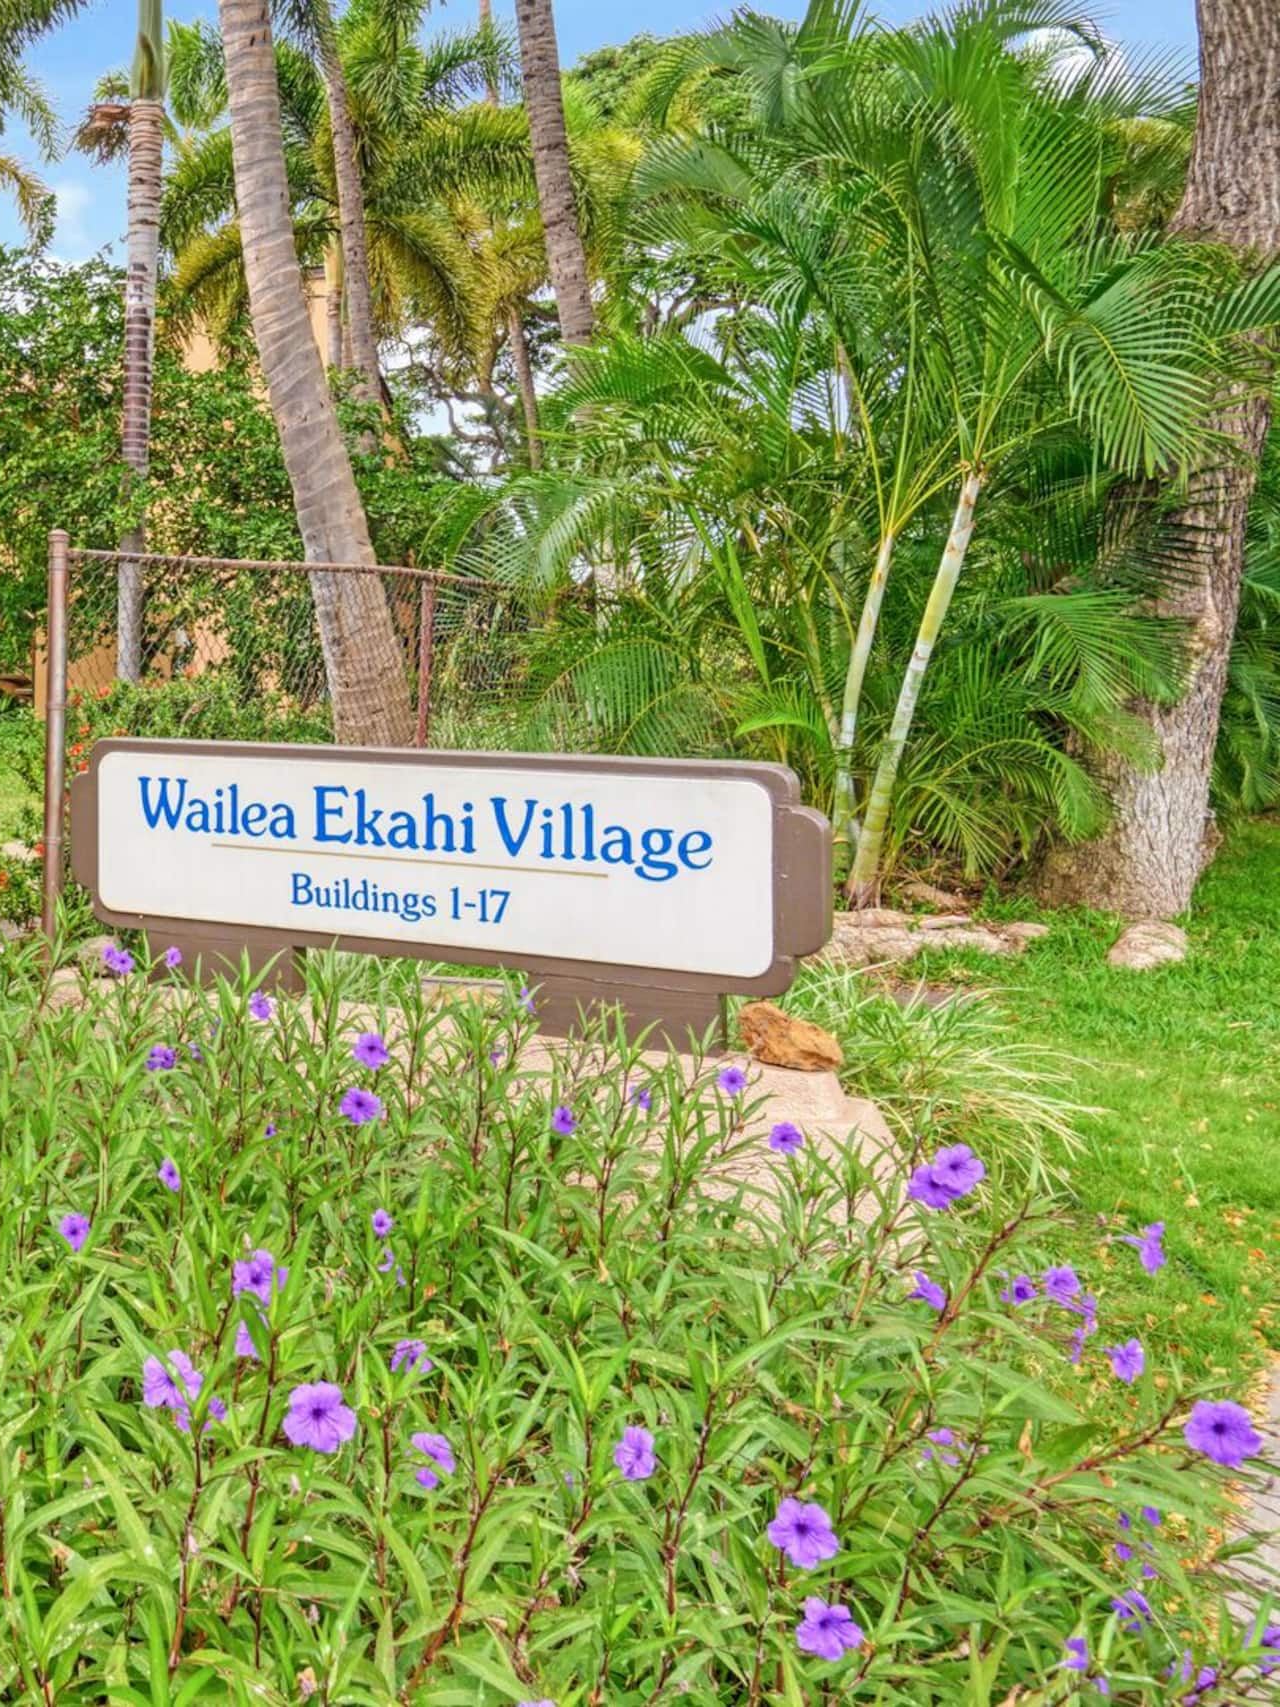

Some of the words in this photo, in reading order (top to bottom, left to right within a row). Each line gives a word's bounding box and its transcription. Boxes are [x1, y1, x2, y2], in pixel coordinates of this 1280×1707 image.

[138, 775, 297, 841] Wailea
[313, 785, 476, 855] Ekahi
[491, 796, 714, 883] Village
[291, 871, 438, 921] Buildings
[451, 885, 511, 925] 1-17
